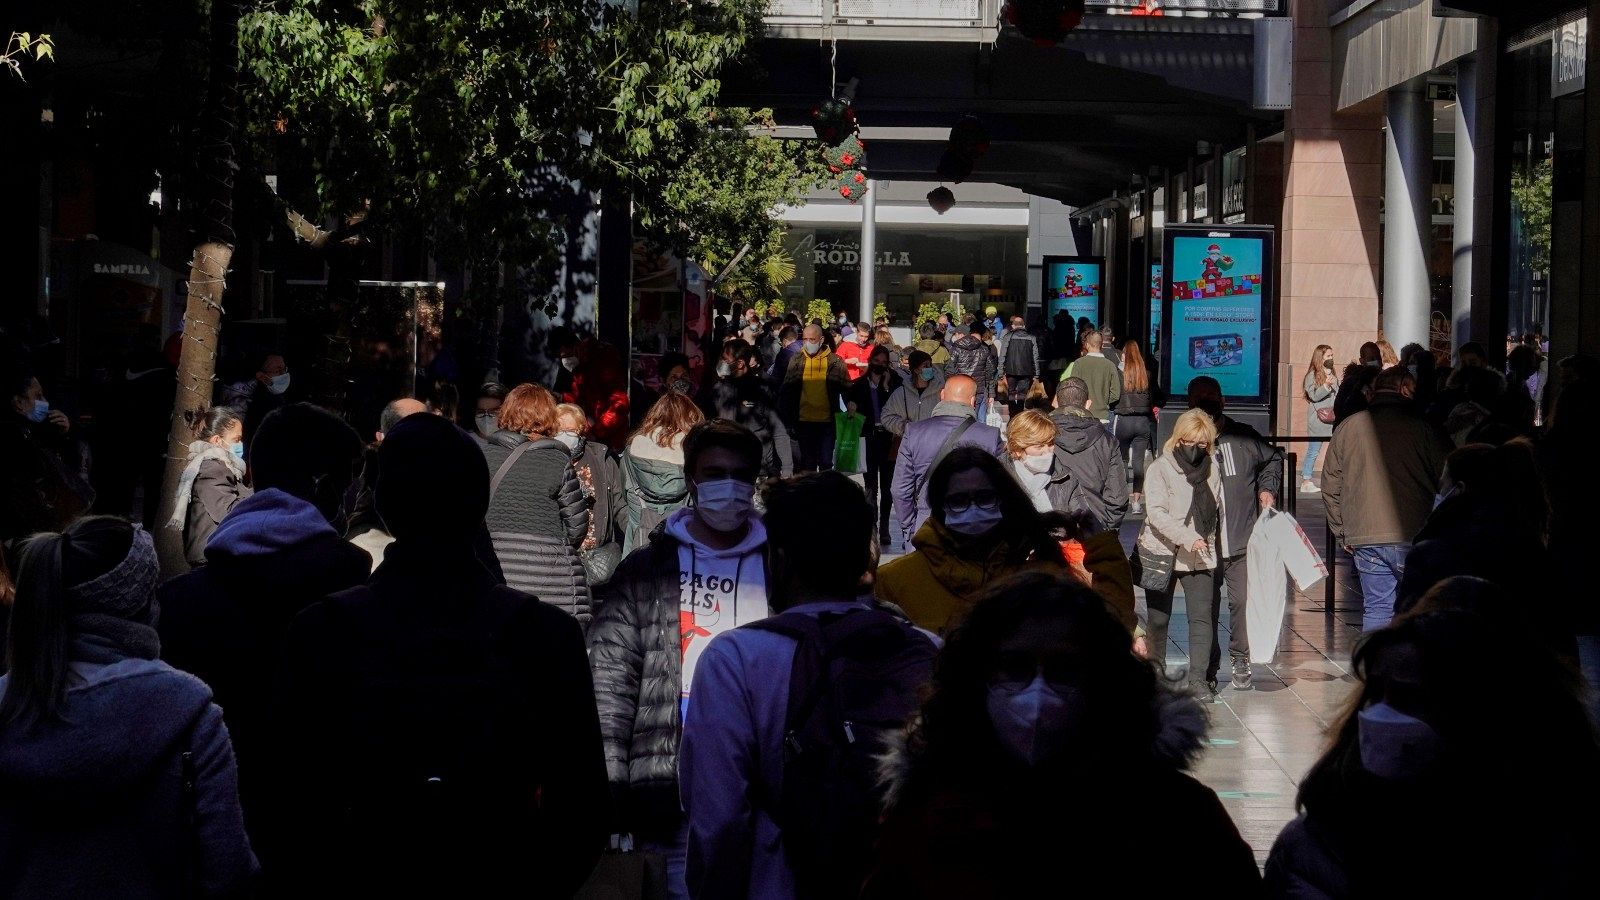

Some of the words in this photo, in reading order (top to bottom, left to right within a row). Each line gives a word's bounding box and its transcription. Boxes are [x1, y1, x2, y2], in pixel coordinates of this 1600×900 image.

[813, 250, 912, 266] RODLLA
[679, 571, 734, 594] CAGO
[679, 589, 715, 609] LLS
